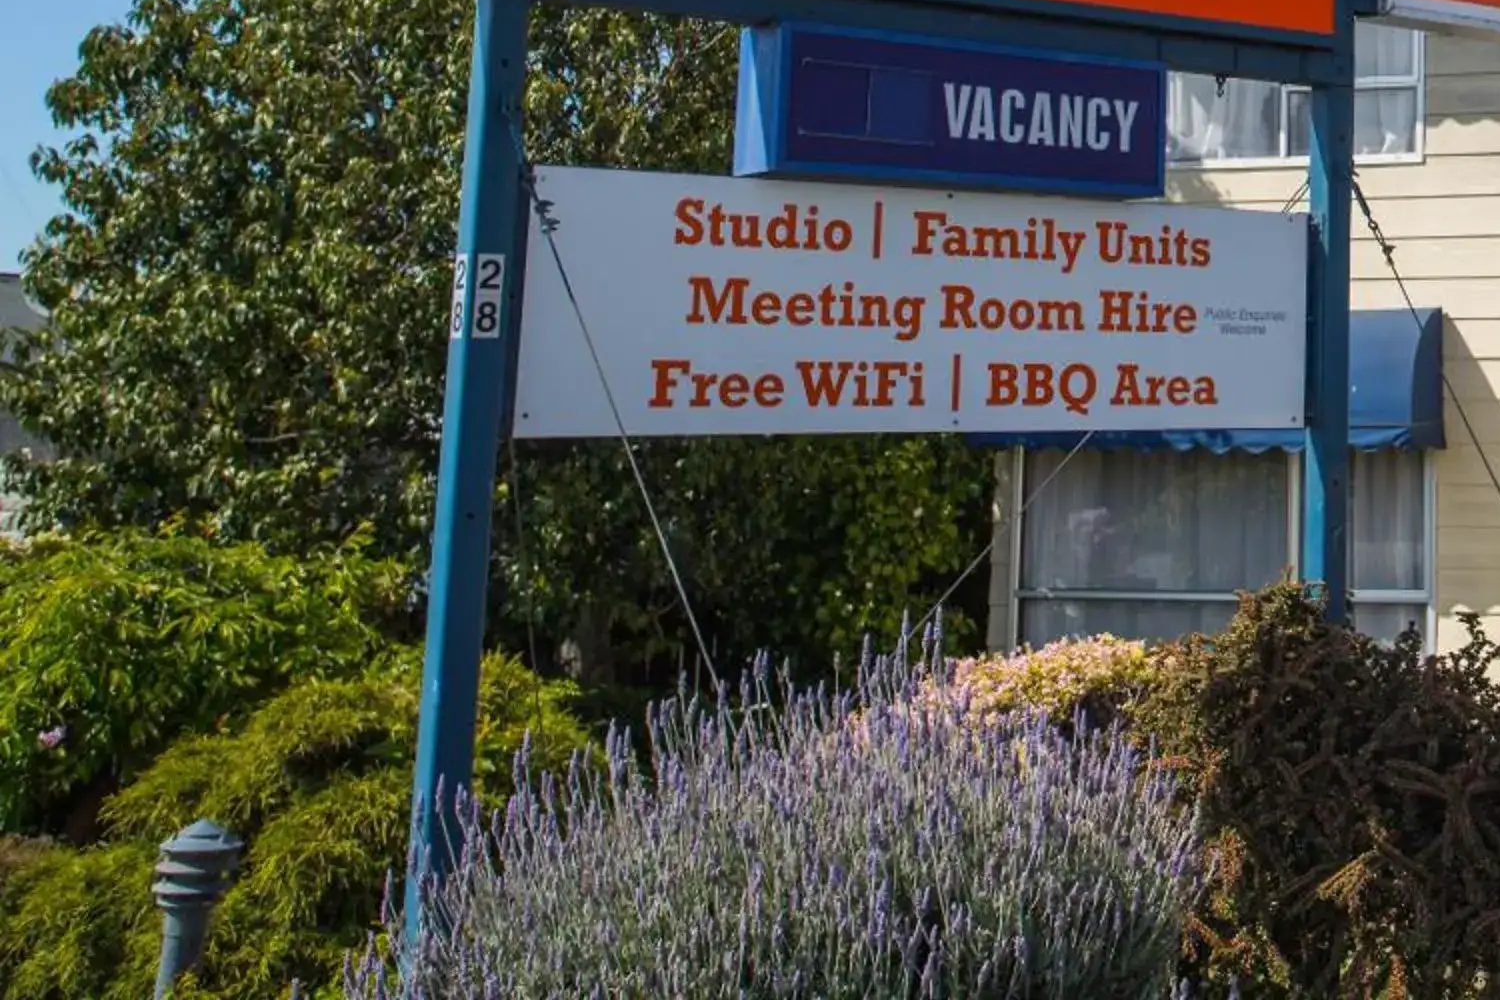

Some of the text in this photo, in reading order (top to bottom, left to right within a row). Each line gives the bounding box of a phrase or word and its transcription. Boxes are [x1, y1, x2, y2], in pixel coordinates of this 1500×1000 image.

[943, 83, 1138, 152] VACANCY
[674, 197, 1211, 273] Studio Family Units
[686, 276, 1197, 341] Meeting Room Hire
[648, 359, 1218, 415] Free WiFi BBQ Area
